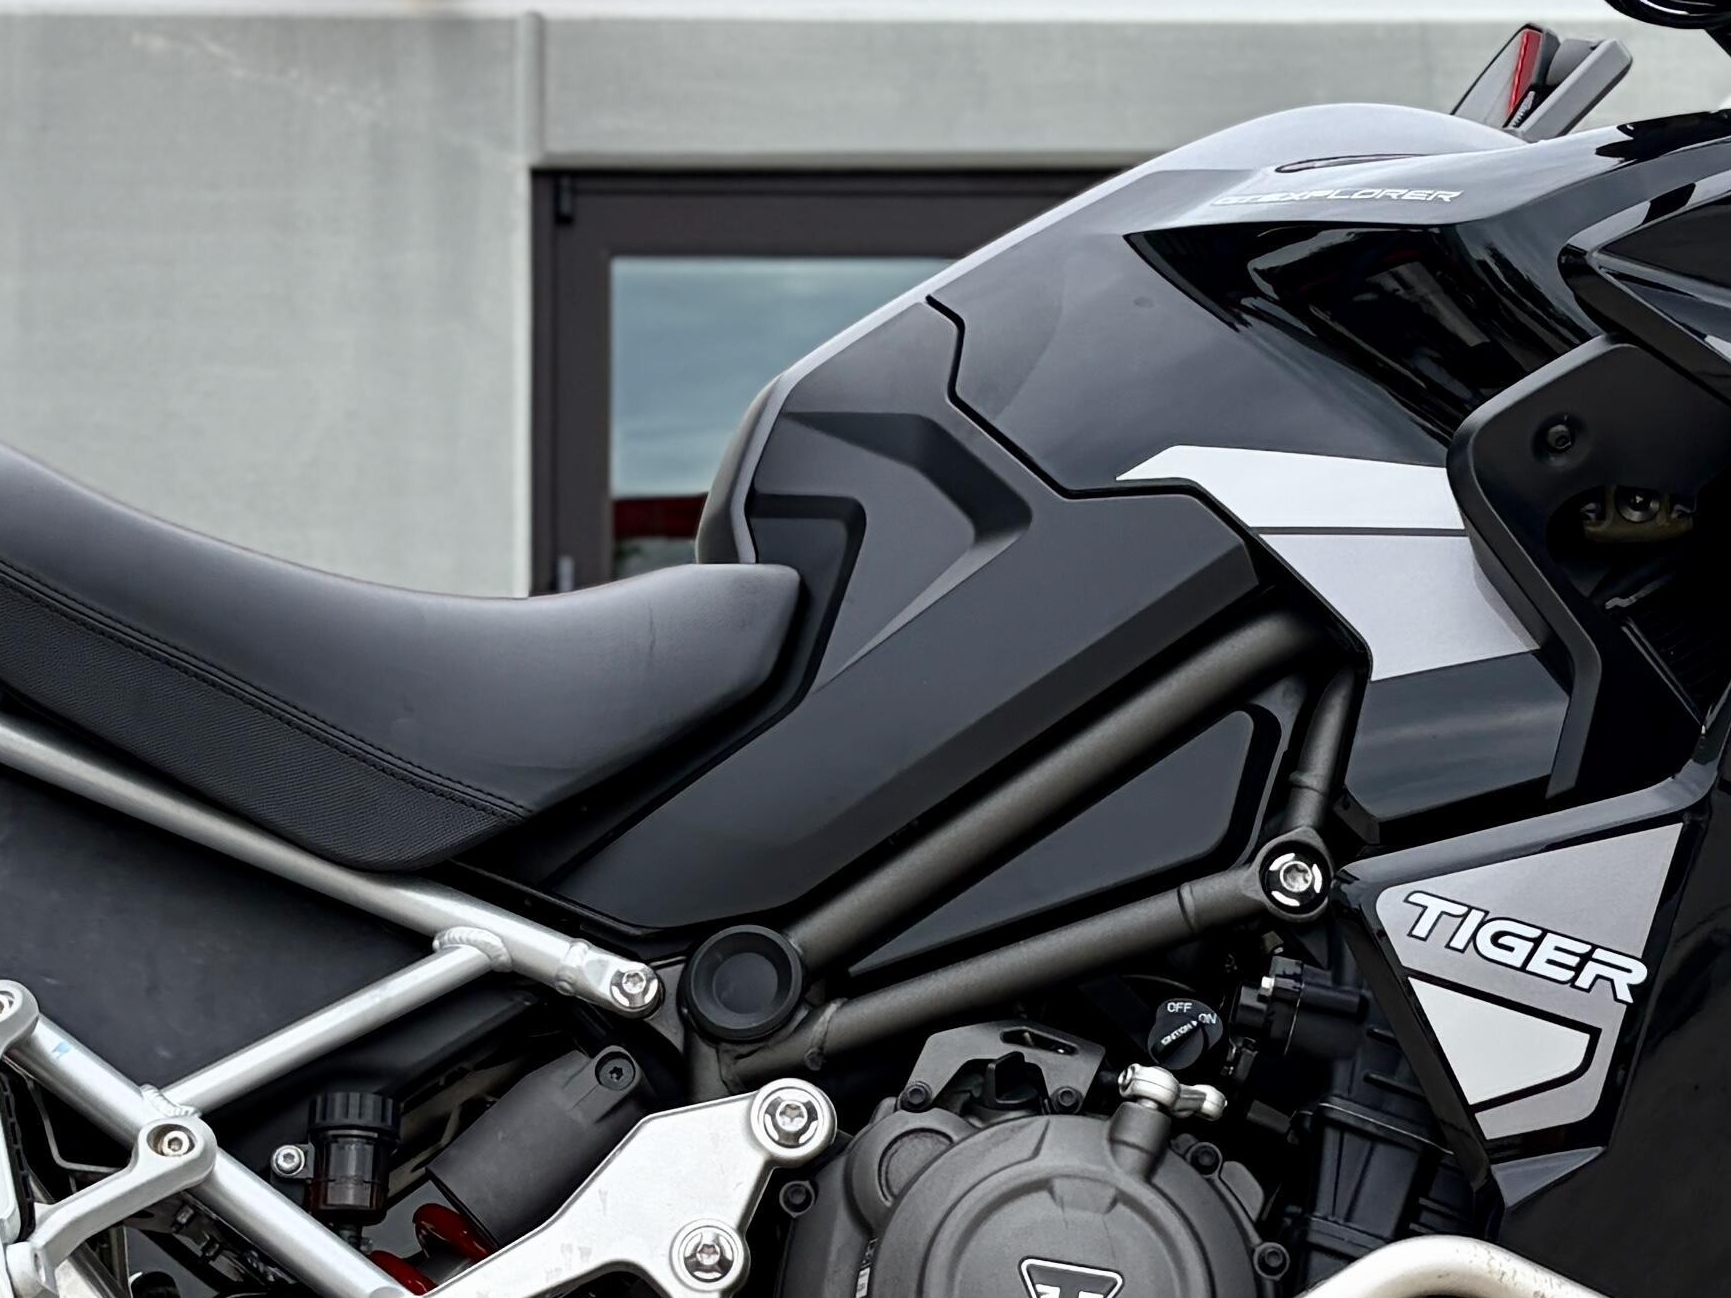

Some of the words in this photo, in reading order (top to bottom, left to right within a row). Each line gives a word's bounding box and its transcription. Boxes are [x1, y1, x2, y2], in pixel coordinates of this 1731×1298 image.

[1405, 890, 1649, 1005] TIGER
[1167, 1002, 1192, 1013] OFF
[1198, 1013, 1217, 1024] ON
